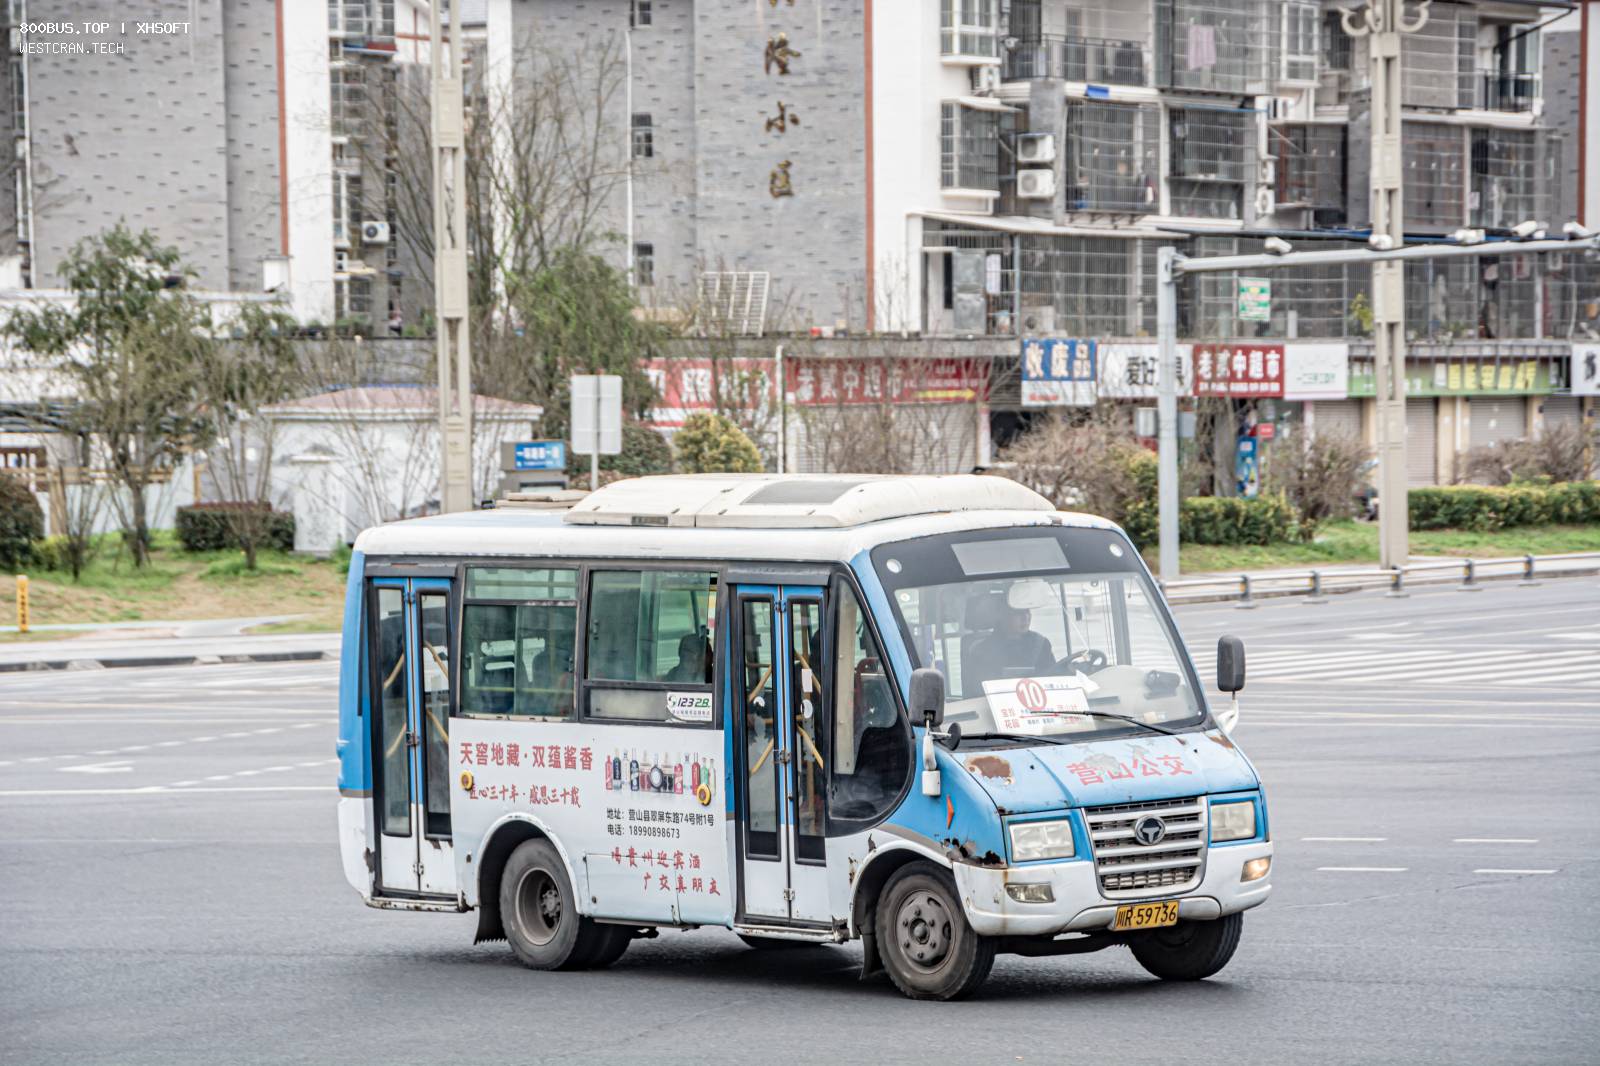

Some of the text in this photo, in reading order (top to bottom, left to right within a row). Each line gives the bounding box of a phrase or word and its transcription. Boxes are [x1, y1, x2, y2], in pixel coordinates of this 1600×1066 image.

[763, 0, 802, 198] 隆小区
[677, 697, 710, 708] 12328
[1020, 682, 1041, 709] 10
[1066, 754, 1194, 786] 营山公交
[643, 871, 721, 897] 广交真朋友
